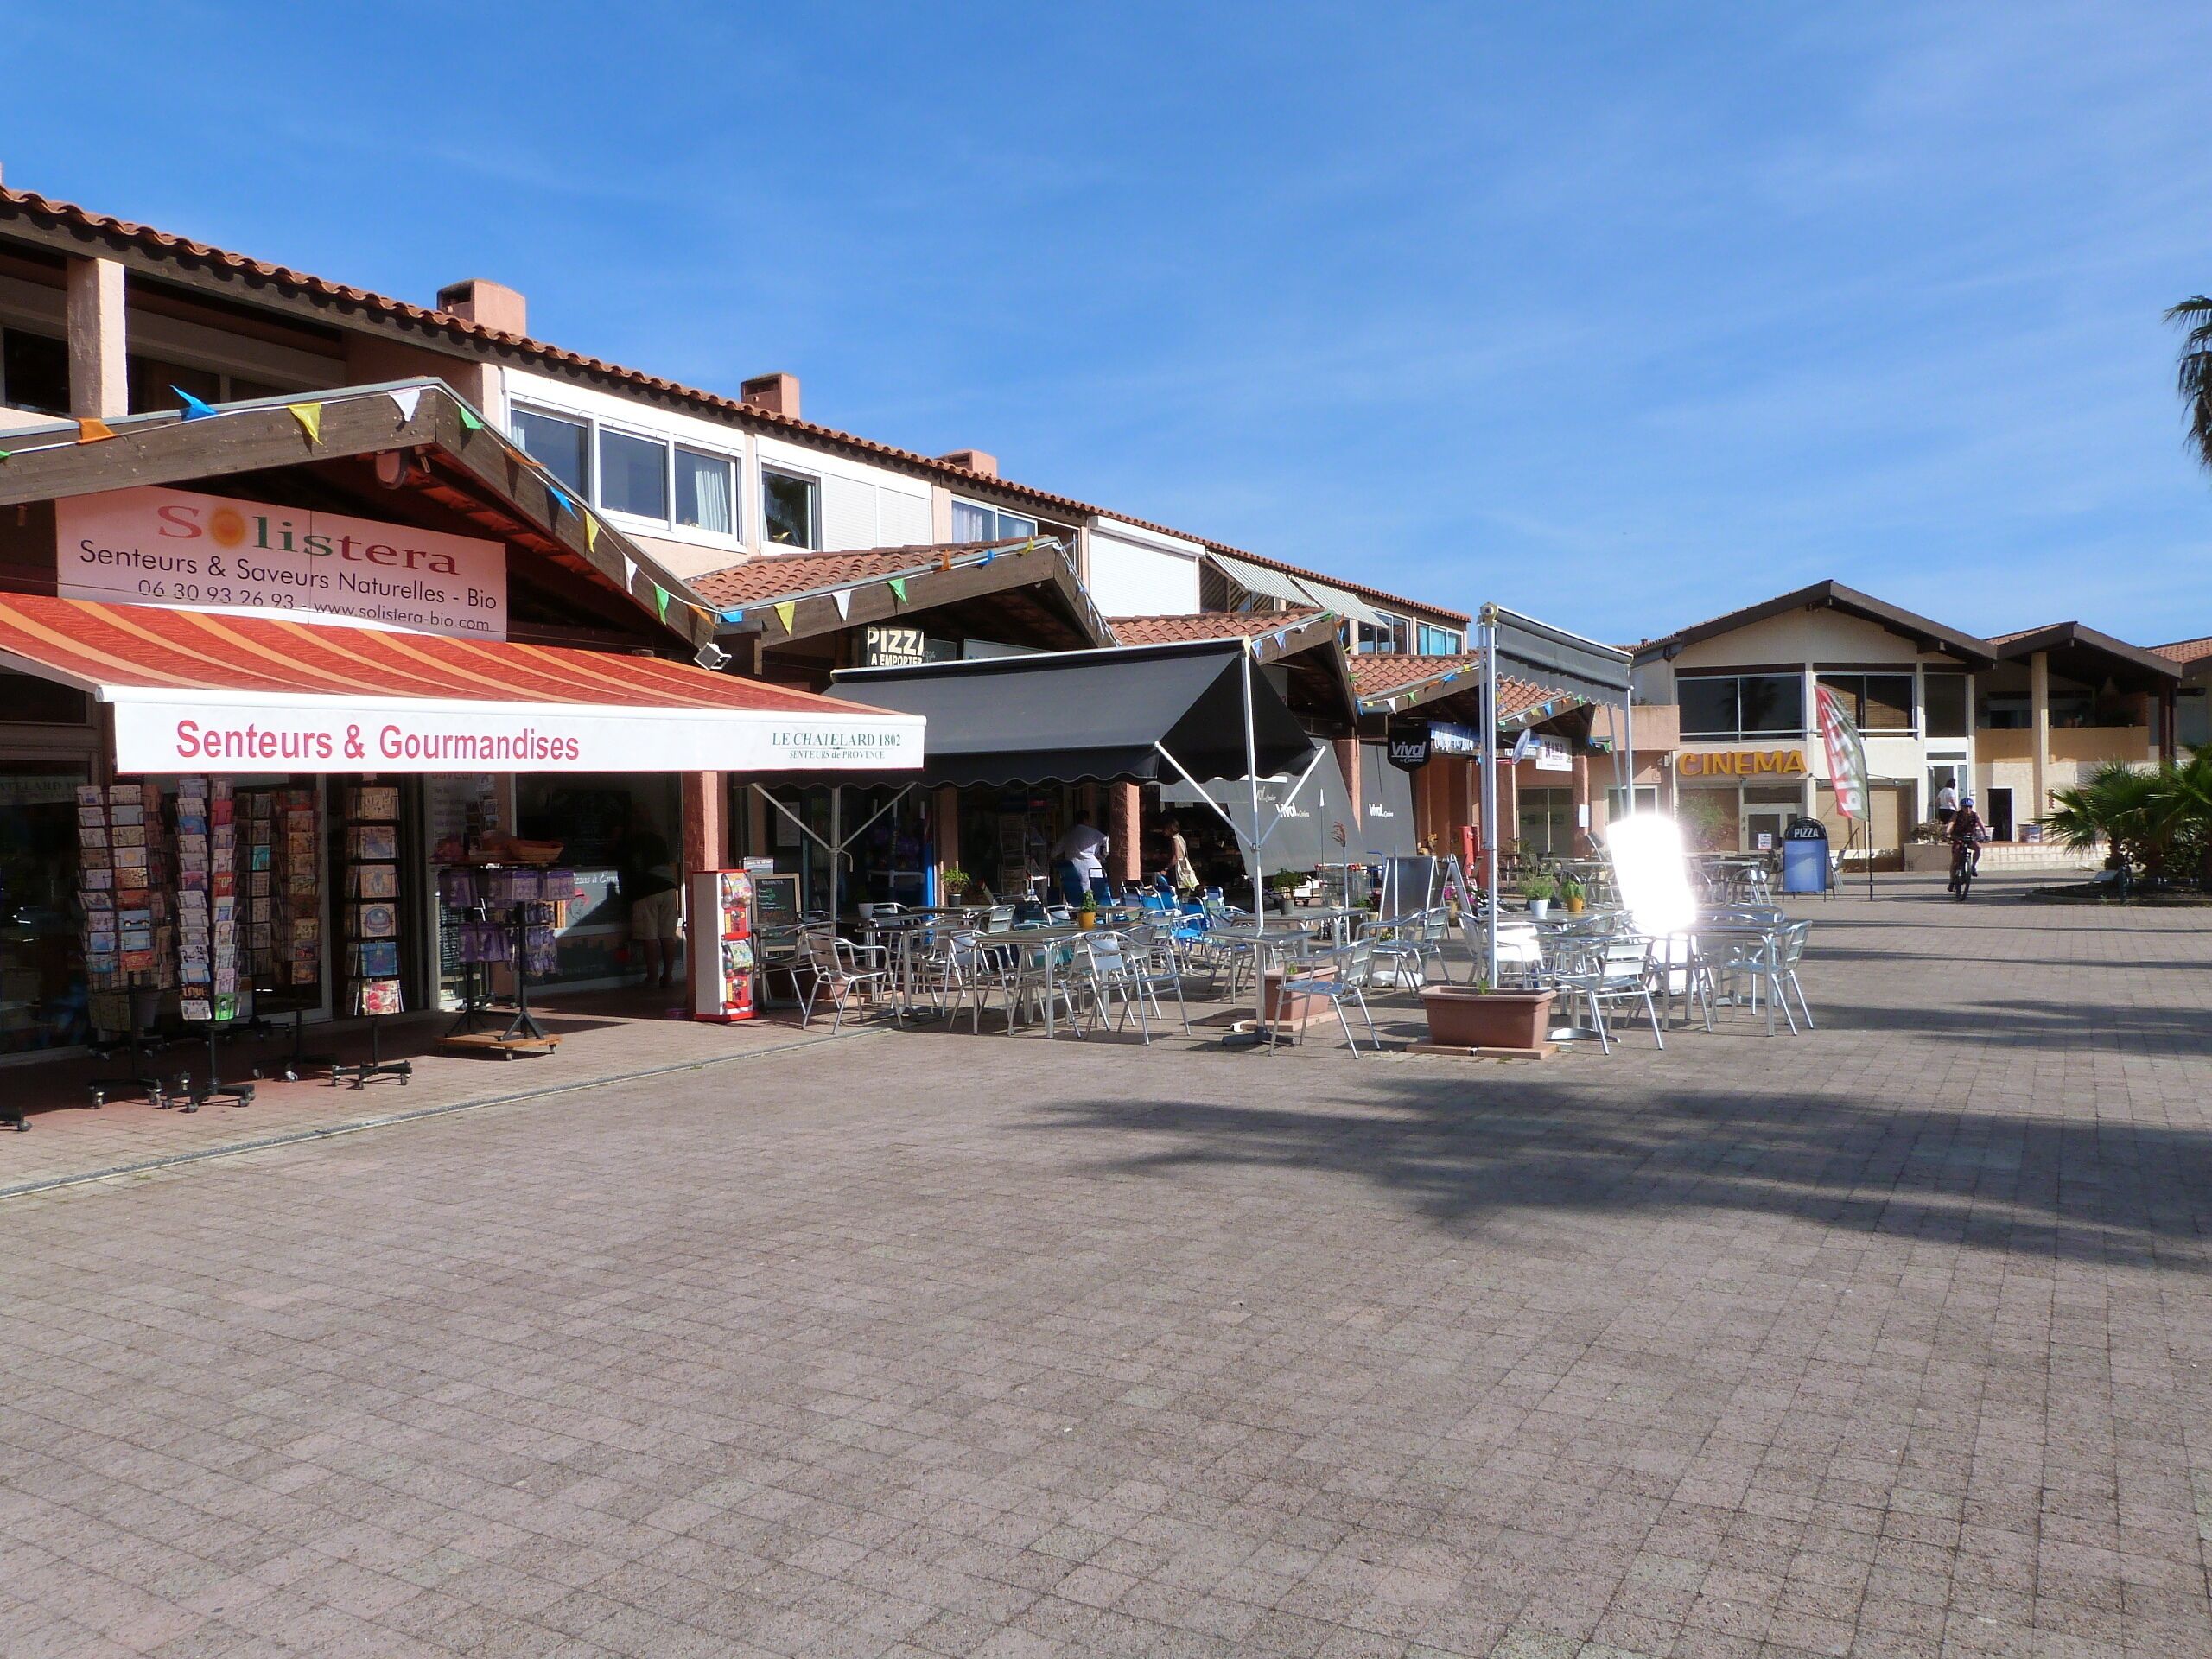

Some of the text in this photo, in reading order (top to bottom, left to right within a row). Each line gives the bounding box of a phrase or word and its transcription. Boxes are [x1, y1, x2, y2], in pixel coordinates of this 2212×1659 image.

[79, 539, 198, 575] Senteurs
[208, 556, 226, 577] &
[237, 558, 329, 589] Saveurs
[339, 570, 445, 603] Naturelles
[468, 588, 497, 609] Bio
[138, 579, 165, 598] 06
[174, 582, 200, 601] 30
[207, 586, 232, 604] 93
[271, 593, 294, 610] 93
[871, 654, 878, 665] A
[176, 720, 580, 760] Senteurs & Gourmandises
[772, 733, 901, 747] LE CHATELARD 1802
[789, 750, 830, 760] SENTEURS
[842, 750, 885, 760] PROVENCE
[1679, 750, 1808, 776] CINEMA
[1794, 828, 1819, 838] PIZZA
